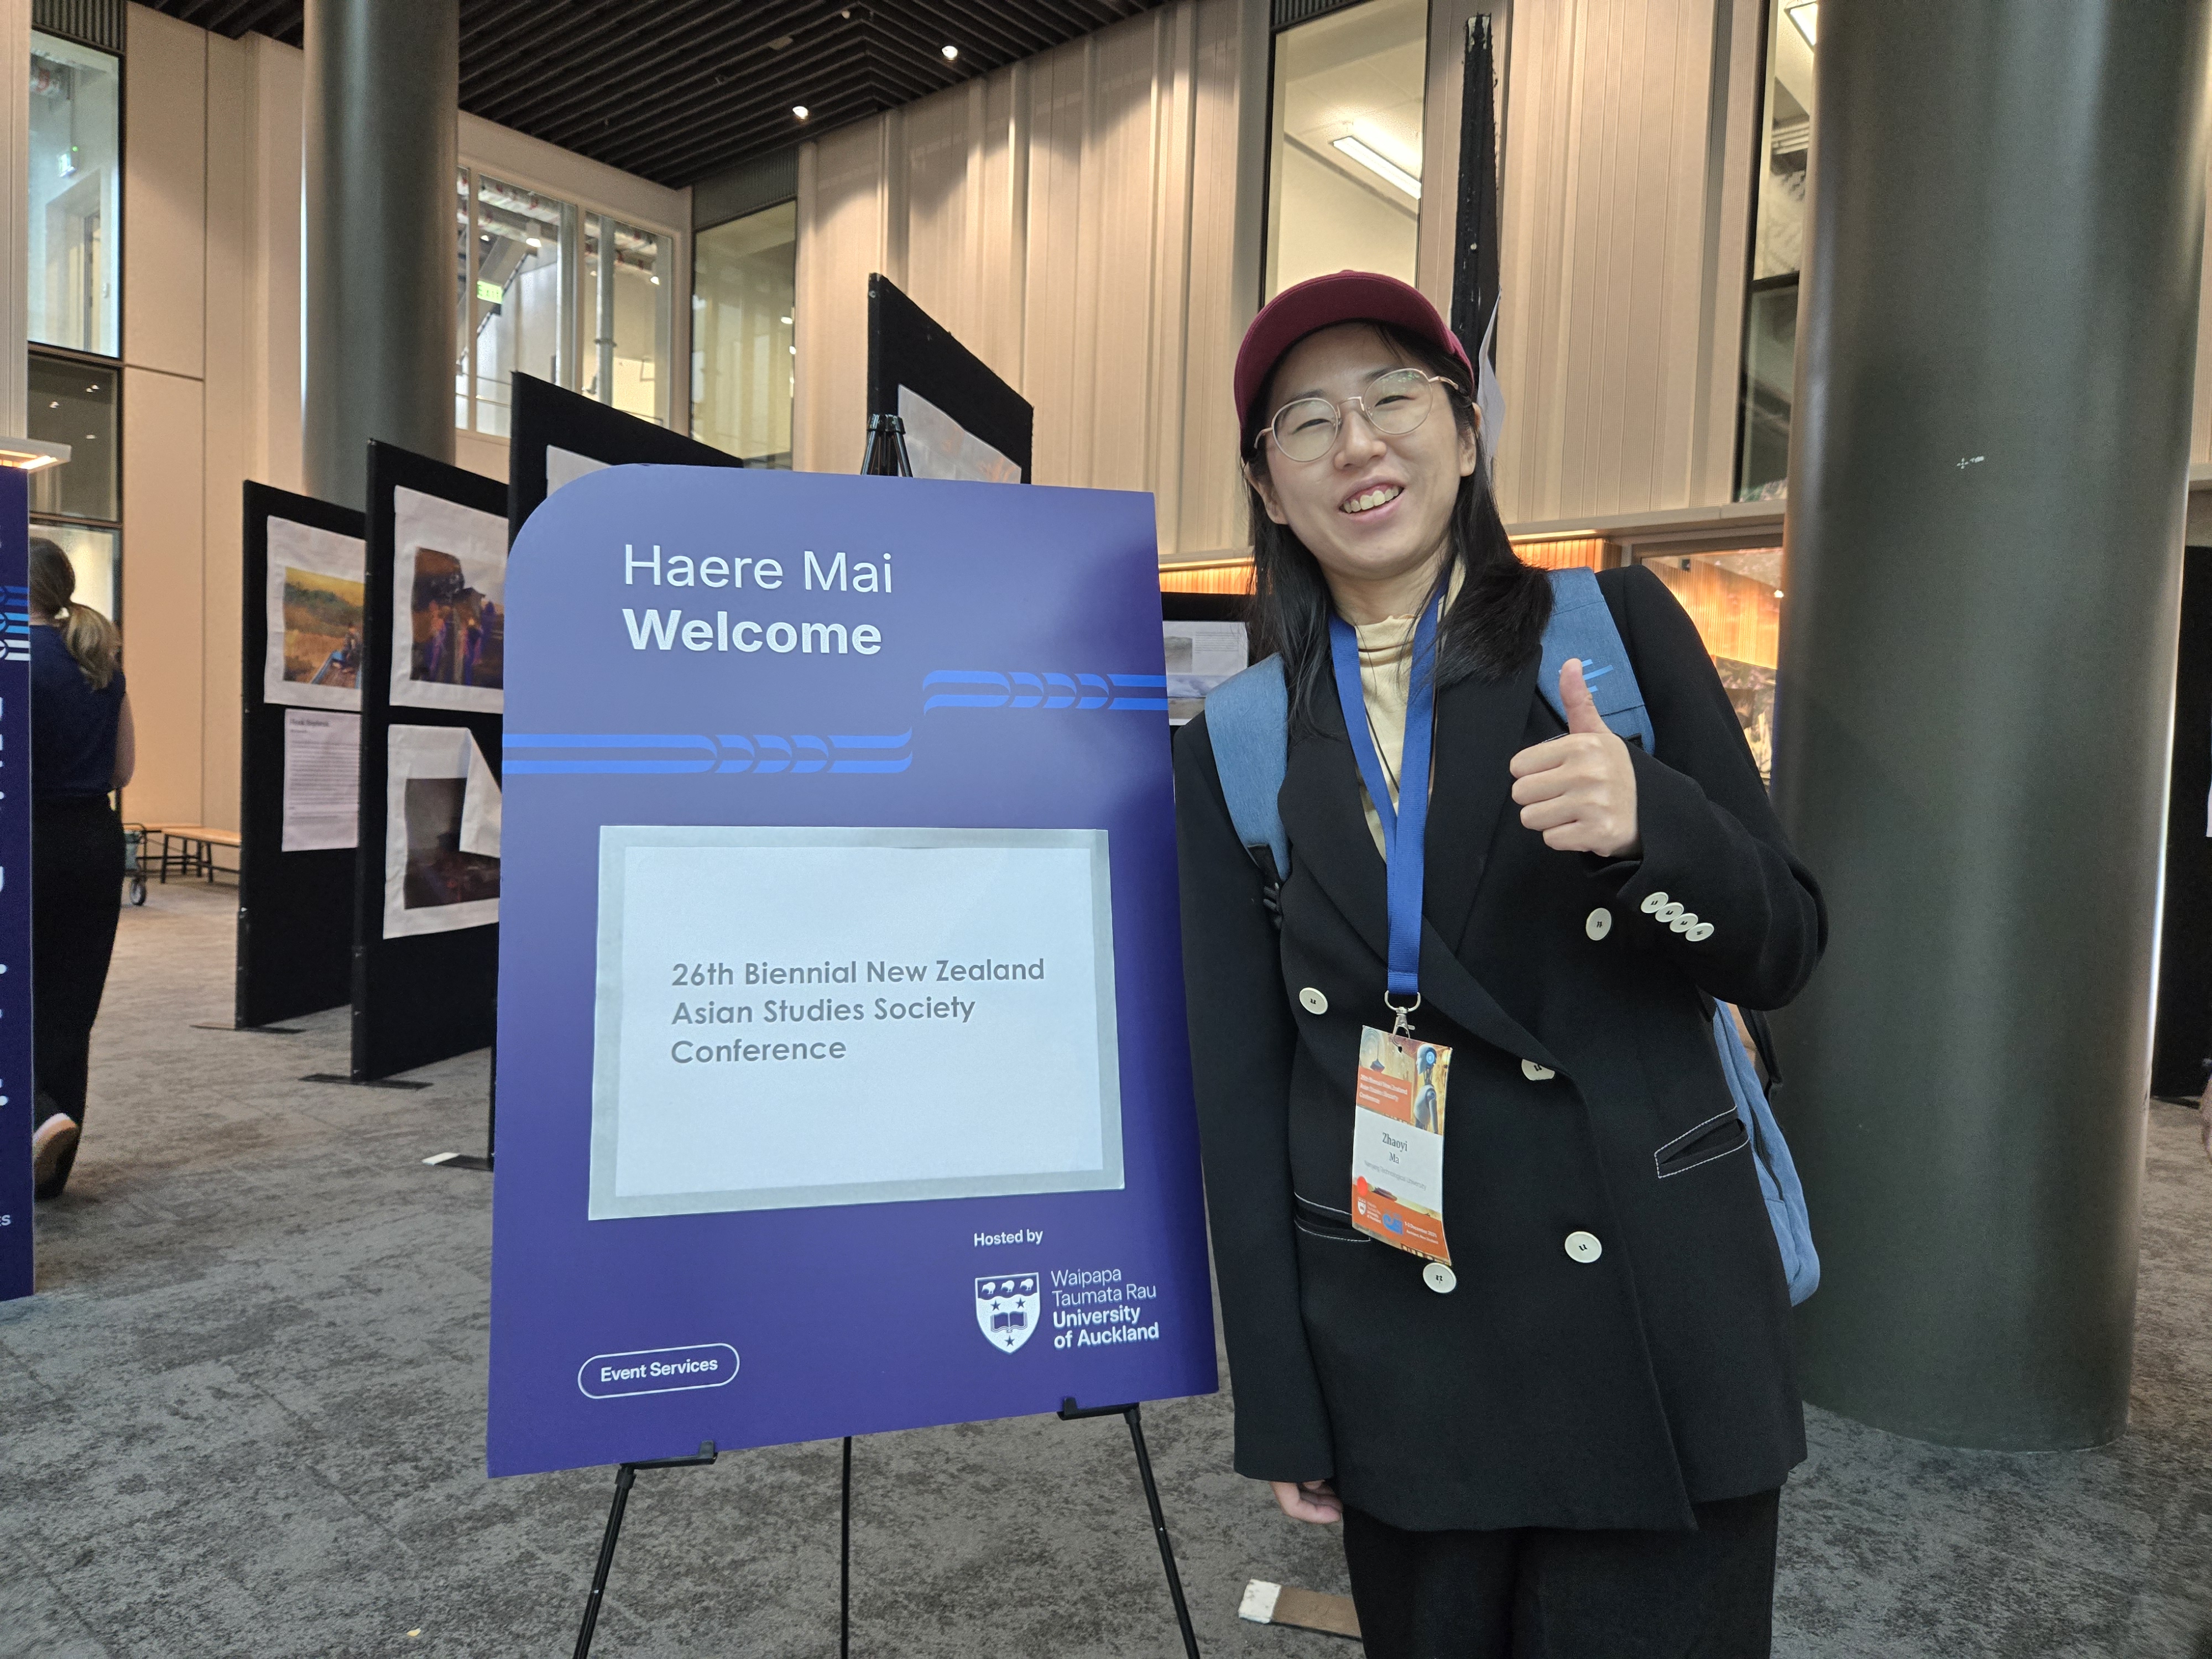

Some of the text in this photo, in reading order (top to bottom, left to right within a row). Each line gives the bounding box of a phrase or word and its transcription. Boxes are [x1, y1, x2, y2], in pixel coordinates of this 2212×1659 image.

[625, 544, 892, 593] Haere Mai
[622, 608, 882, 655] Welcome
[671, 958, 1045, 986] 26th Biennial New Zealand
[671, 995, 975, 1025] Asian Studies Society
[671, 1039, 847, 1064] Conference
[1382, 1132, 1408, 1152] Zhaoyi
[1389, 1151, 1400, 1164] Ma
[974, 1229, 1044, 1247] Hosted by
[1051, 1268, 1121, 1288] Waipapa
[1052, 1284, 1157, 1307] Taumata Rau
[1053, 1305, 1141, 1328] University
[1054, 1322, 1160, 1349] of Auckland
[601, 1358, 718, 1383] Event Services
